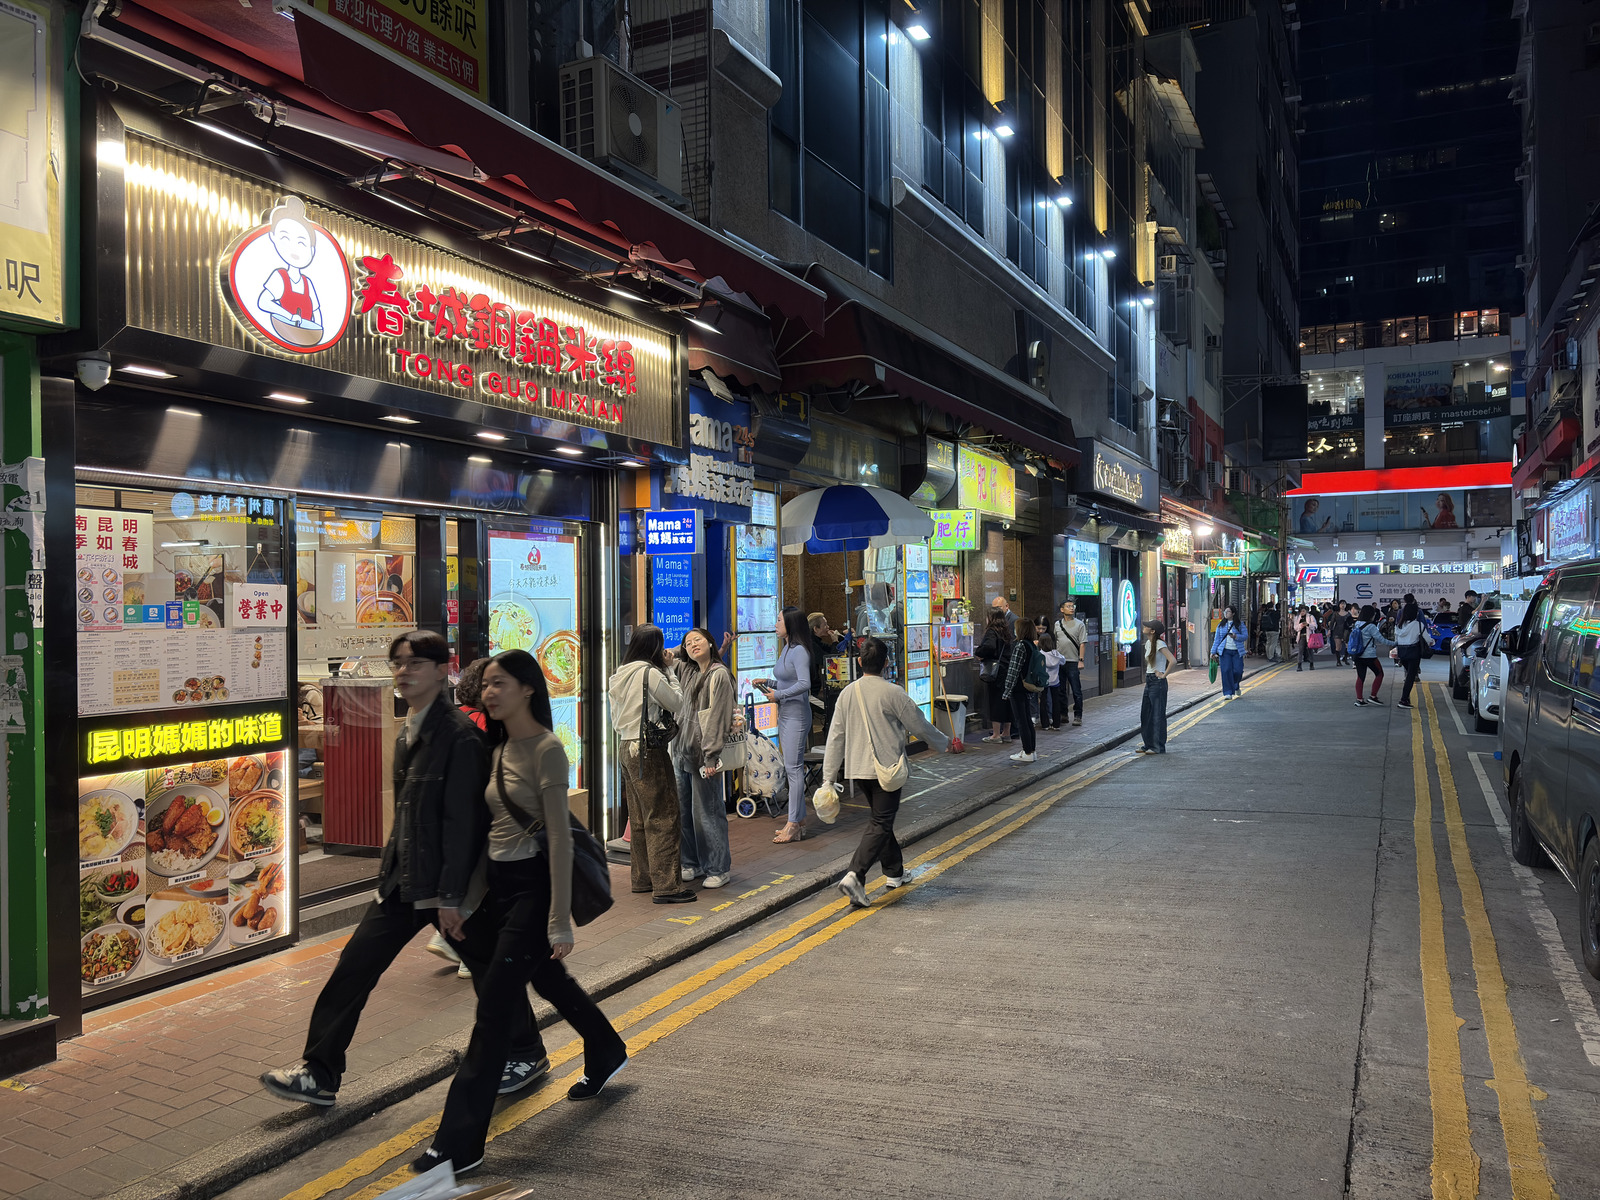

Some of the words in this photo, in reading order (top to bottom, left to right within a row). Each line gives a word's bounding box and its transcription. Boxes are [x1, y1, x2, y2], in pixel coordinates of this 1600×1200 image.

[334, 0, 420, 56] 歡迎代理介紹
[423, 37, 474, 84] 業主付佣
[359, 253, 637, 395] 春城銅鍋米線
[1418, 369, 1439, 378] SUSHI
[396, 347, 474, 387] TONG
[487, 372, 539, 402] GUO
[551, 387, 623, 424] MIXIAN
[1441, 406, 1502, 418] masterbeef.hk
[977, 460, 998, 507] 肥仔
[647, 519, 681, 531] Mama
[936, 521, 971, 538] 肥仔
[656, 557, 682, 570] Mama
[1413, 564, 1441, 574] BEA
[1441, 562, 1485, 574] 東亞銀行
[238, 598, 283, 620] 營業中
[656, 612, 683, 623] Mama
[88, 713, 282, 764] 昆明媽媽的味道
